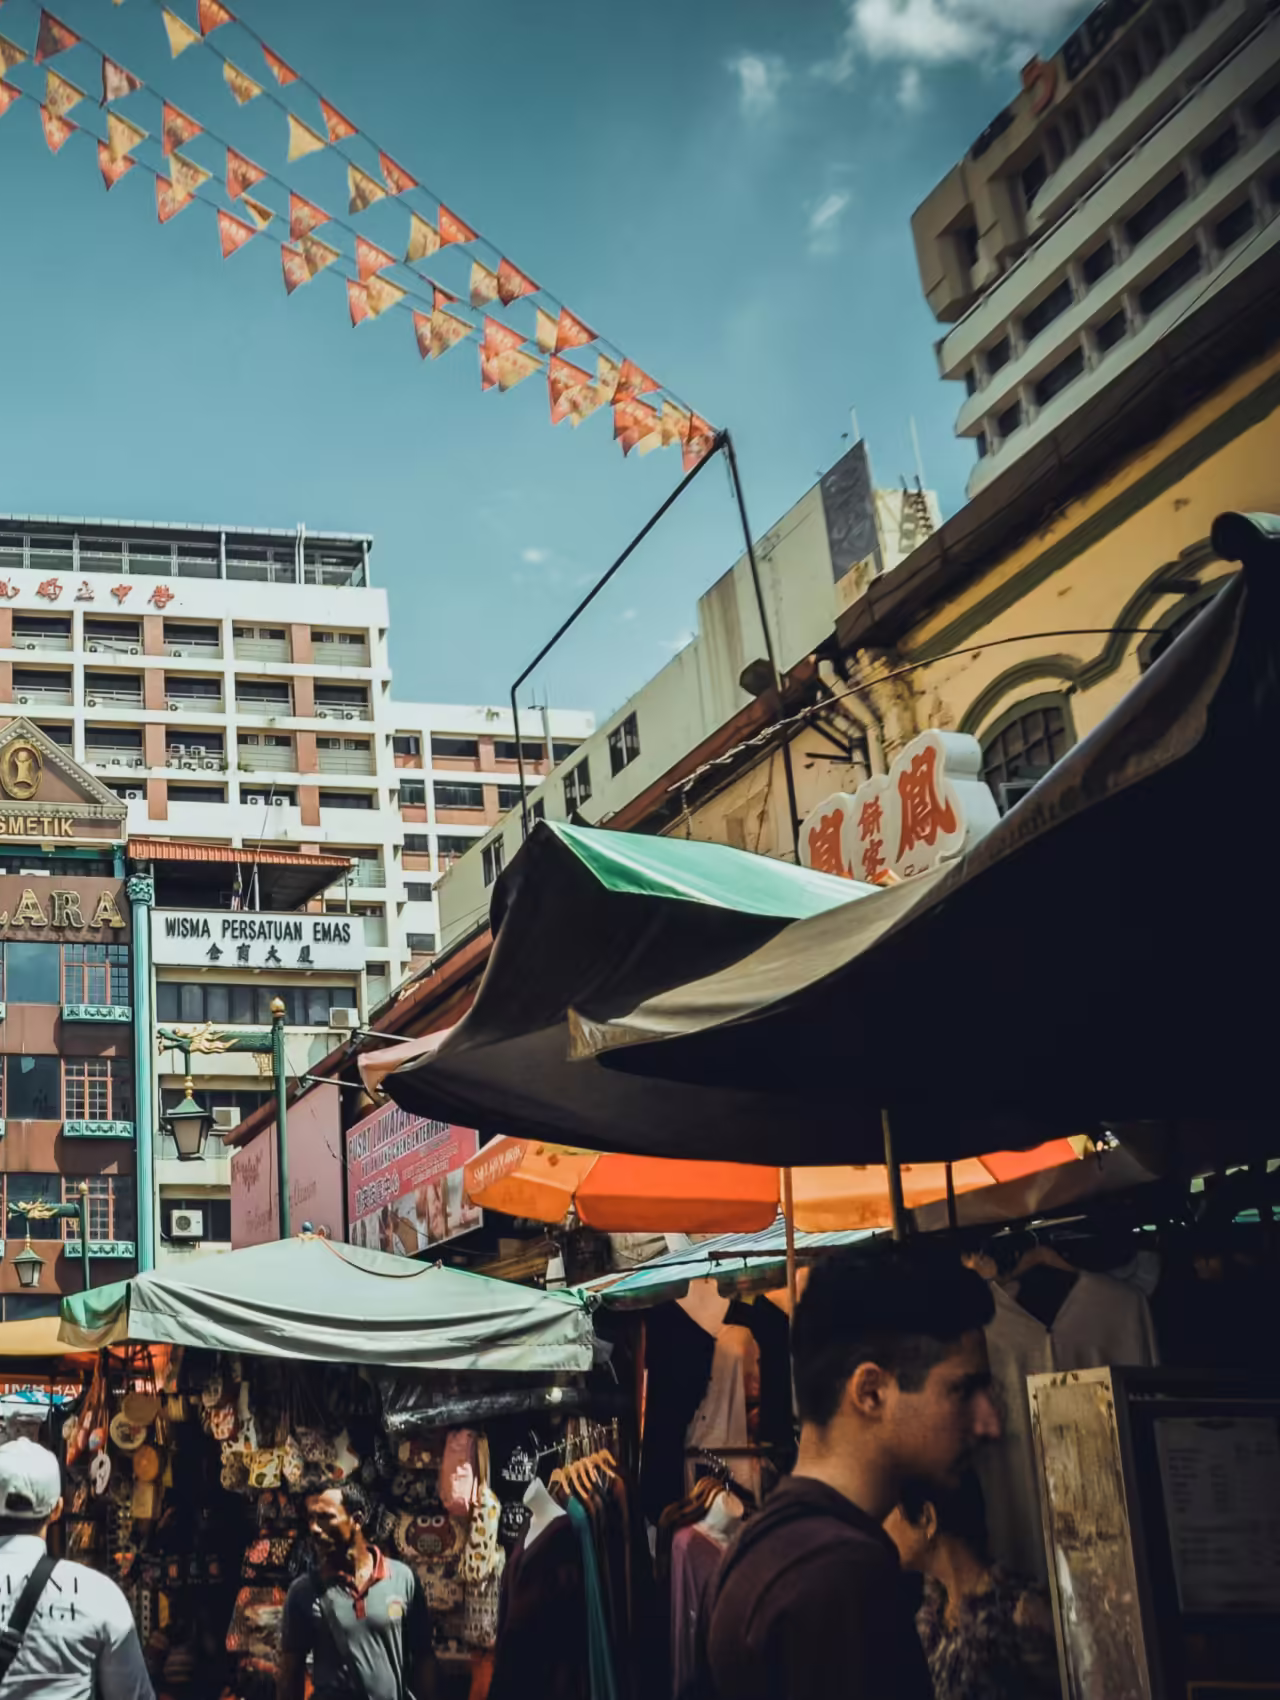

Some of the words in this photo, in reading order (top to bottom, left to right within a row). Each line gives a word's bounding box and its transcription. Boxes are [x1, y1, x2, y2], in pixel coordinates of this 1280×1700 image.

[165, 916, 211, 939] WISMA
[222, 918, 303, 942] PERSATUAN
[313, 921, 351, 943] EMAS
